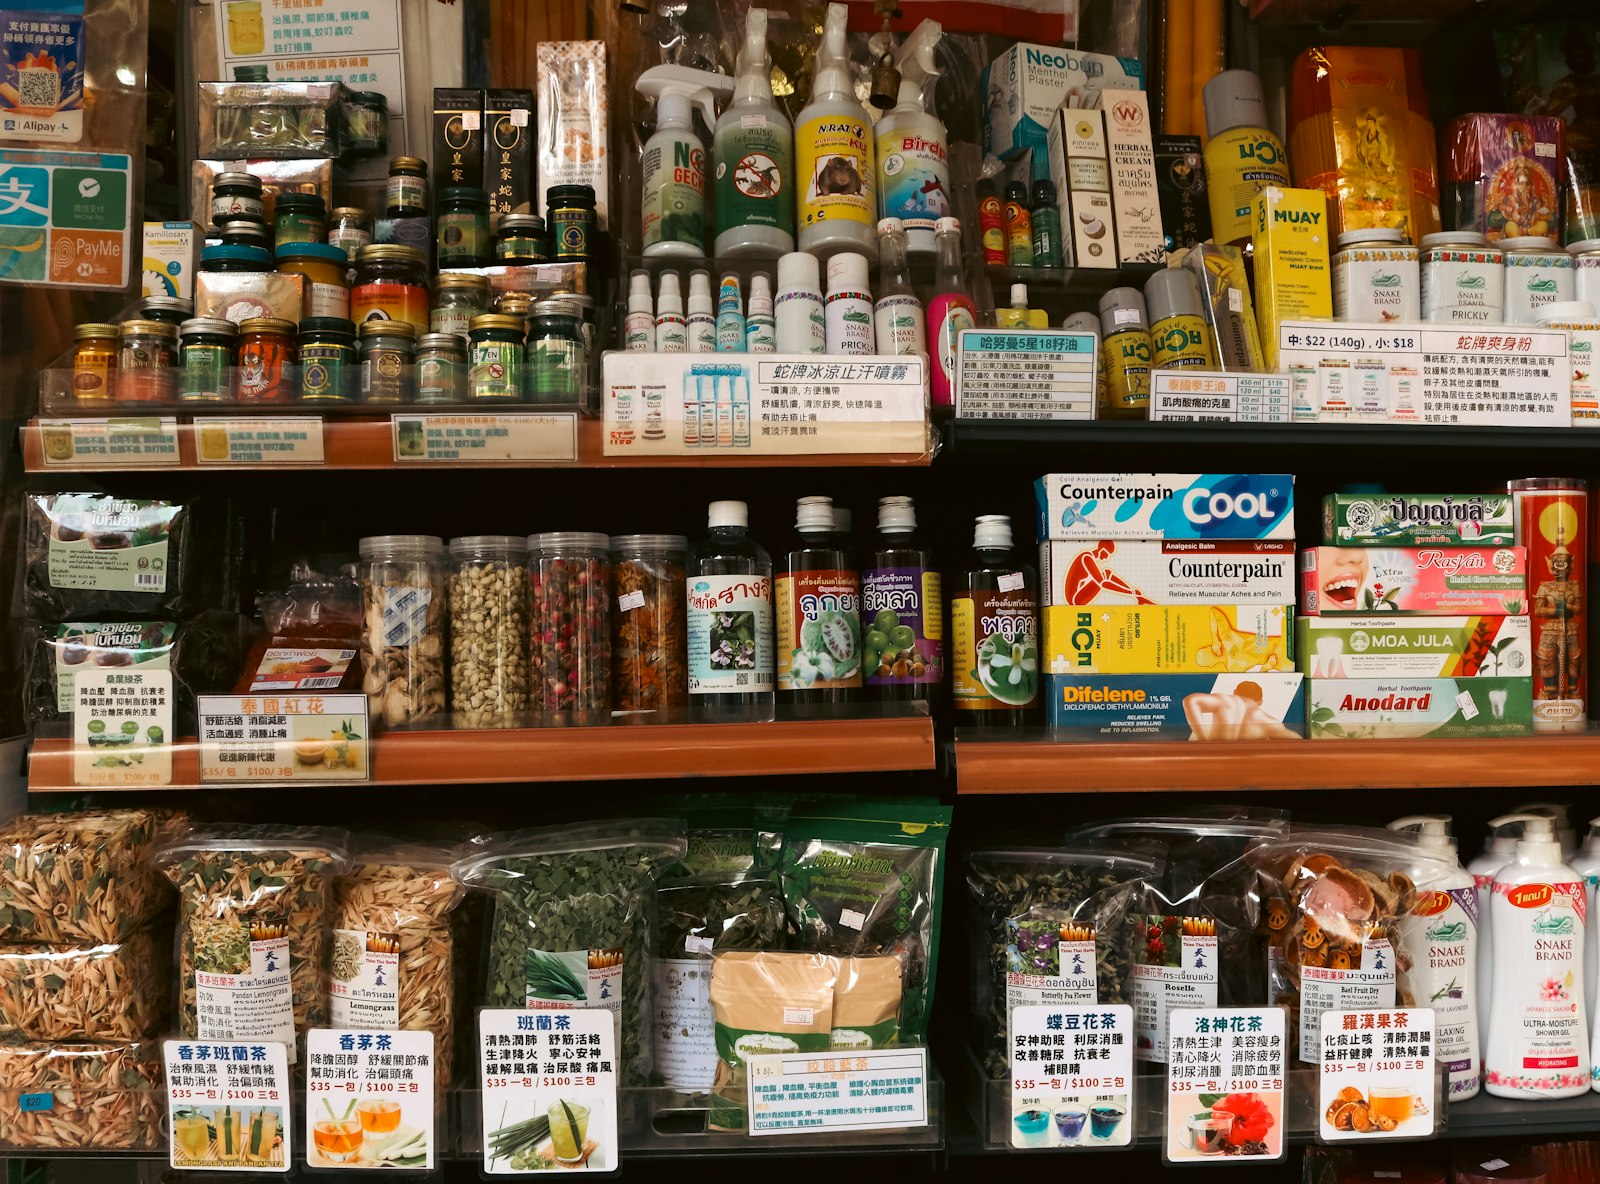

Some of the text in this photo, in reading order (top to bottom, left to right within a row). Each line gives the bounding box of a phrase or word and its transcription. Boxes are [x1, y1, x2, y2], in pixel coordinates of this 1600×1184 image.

[1026, 48, 1104, 76] Neobun
[1028, 65, 1068, 79] Menthol
[1028, 75, 1065, 88] Plaster
[23, 121, 56, 132] Alipay
[451, 151, 464, 182] 皇家
[1115, 157, 1152, 165] CREAM
[499, 151, 513, 213] 皇家蛇油
[1274, 209, 1321, 225] MUAY
[179, 238, 189, 246] M
[76, 238, 120, 258] PayMe
[1373, 290, 1401, 298] SNAKE
[1457, 291, 1485, 299] SNAKE
[1529, 294, 1557, 302] SNAKE
[1374, 296, 1401, 305] BRAND
[1458, 299, 1484, 307] BRAND
[1452, 310, 1489, 321] PRICKLY
[844, 323, 870, 333] SNAKE
[890, 329, 915, 338] SNAKE
[846, 330, 870, 339] BRAND
[841, 341, 874, 351] PRICKLY
[980, 336, 1078, 351] 哈努曼5星18籽油
[1288, 334, 1414, 349] 中: $22 (140g) 小: $18
[1456, 335, 1533, 352] 蛇牌爽身粉
[1423, 355, 1459, 364] 傳統配方,
[772, 364, 909, 381] 蛇牌冰涼止汗噴霧
[1168, 379, 1227, 393] 泰國拳王油
[761, 400, 883, 409] 舒緩肌膚, 清涼舒爽, 快速降溫
[761, 426, 818, 436] 減淡汗臭異味
[1076, 476, 1110, 484] Analgesic
[1060, 484, 1173, 503] Counterpain
[1182, 487, 1276, 524] COOL
[1166, 543, 1197, 551] Analgesic
[1417, 549, 1487, 577] Rasyan
[1168, 557, 1283, 582] Counterpain
[1388, 575, 1412, 583] White
[1372, 634, 1454, 647] MOA JULA
[106, 674, 143, 684] 桑葉綠茶
[80, 687, 165, 696] 降血壓 降血脂 抗衰老
[1063, 686, 1146, 703] Difelene
[1400, 685, 1433, 693] Toothpaste
[240, 697, 325, 715] 泰國紅花
[1064, 702, 1169, 711] DICLOFENAC DIETHYLAMMONIUM
[1340, 693, 1432, 712] Anodard
[91, 708, 158, 717] 防治糖尿病的克星
[205, 716, 287, 726] 舒筋活絡 消脂減肥
[206, 729, 287, 739] 活血通經 消腫止痛
[219, 752, 275, 763] 促進新陳代謝
[1535, 939, 1573, 950] SNAKE
[1429, 945, 1466, 958] SNAKE
[1536, 951, 1573, 961] BRAND
[1430, 957, 1466, 968] BRAND
[232, 987, 288, 999] Pandan Lemongrass
[1165, 983, 1196, 992] Roselle
[1369, 987, 1380, 995] Dry
[1041, 991, 1064, 999] Butterfly
[350, 1001, 395, 1012] Lemongrass
[517, 1014, 571, 1031] 班蘭茶
[1046, 1013, 1117, 1030] 蝶豆花茶
[1195, 1015, 1263, 1033] 洛神花茶
[1342, 1012, 1409, 1030] 羅漢果茶
[1523, 1019, 1579, 1028] ULTRA-MOISTURE
[339, 1034, 392, 1051] 香茅茶
[485, 1033, 601, 1046] 清熱潤肺 舒筋活絡
[1015, 1033, 1124, 1046] 安神助眠 利尿消腫
[1172, 1035, 1281, 1049] 清熱生津 美容瘦身
[1455, 1035, 1465, 1043] GEL
[178, 1045, 267, 1061] 香茅班蘭茶
[1324, 1060, 1425, 1073] $35 一包 $100 三包
[310, 1082, 419, 1093] $35 一包 $100 三包
[487, 1076, 596, 1088] $35 一包 $100 三包
[1015, 1077, 1125, 1090] $35 一包 $100 三包
[172, 1089, 279, 1100] $35 一包 $100 三包
[25, 1097, 41, 1107] $20
